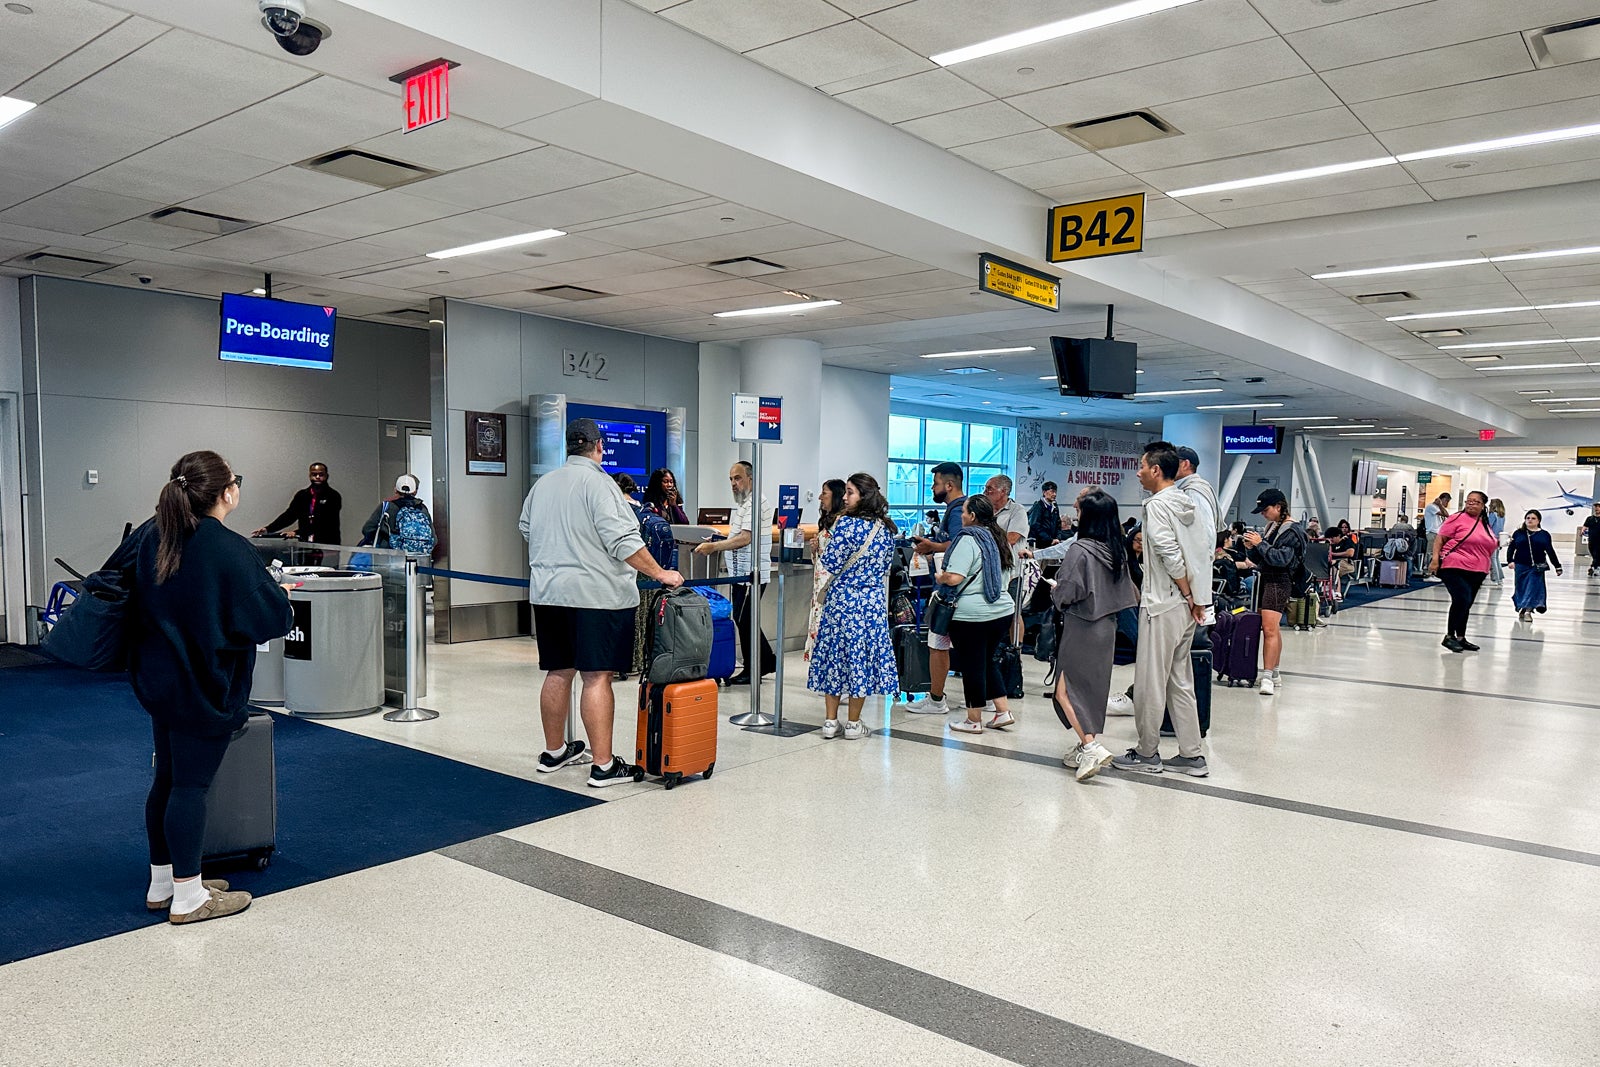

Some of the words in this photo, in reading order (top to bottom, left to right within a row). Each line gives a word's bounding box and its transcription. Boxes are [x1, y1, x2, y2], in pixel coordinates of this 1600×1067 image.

[406, 68, 443, 129] EXIT
[1059, 206, 1135, 252] B42
[997, 269, 1006, 278] Gates
[1025, 278, 1034, 286] Gates
[1026, 291, 1040, 301] Baggage
[226, 317, 330, 348] Pre-Boarding
[562, 348, 609, 381] B42
[1057, 434, 1092, 451] JOURNEY
[1110, 440, 1144, 455] THOUSAN
[1225, 435, 1273, 444] Pre-Boarding
[1052, 451, 1076, 467] MILES
[1077, 453, 1099, 468] MUST
[1099, 456, 1120, 469] BEGIN
[1121, 457, 1139, 470] WITH
[1067, 470, 1074, 484] A
[1075, 471, 1101, 485] SINGLE
